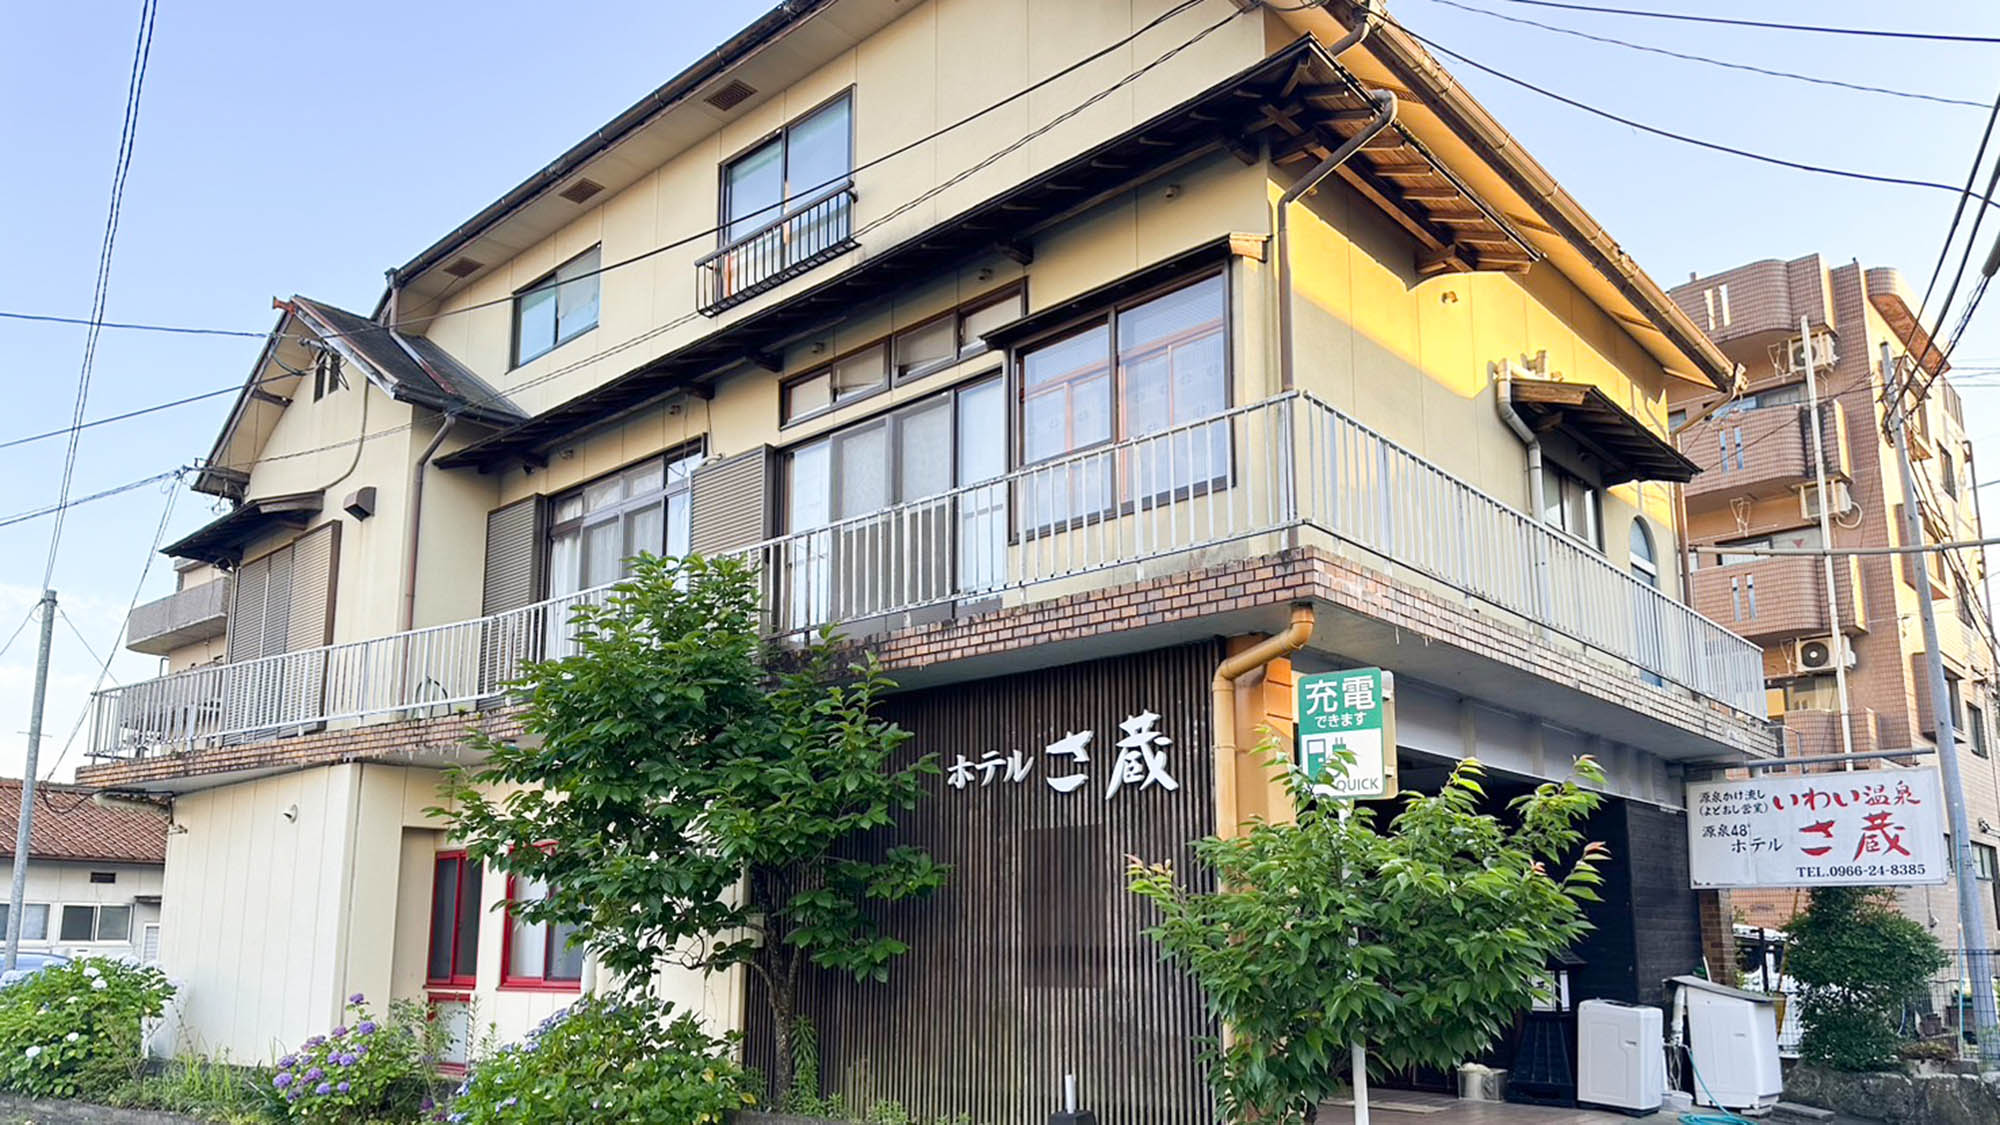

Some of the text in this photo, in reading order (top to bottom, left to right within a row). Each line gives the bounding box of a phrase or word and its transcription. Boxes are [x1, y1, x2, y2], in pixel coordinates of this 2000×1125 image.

[1305, 674, 1376, 715] 充電
[1315, 711, 1367, 728] できます
[947, 709, 1179, 800] ホテル さ蔵
[1336, 777, 1379, 793] QUICK
[1699, 789, 1766, 803] 源泉かけ流し
[1772, 780, 1921, 811] いわい温泉
[1798, 810, 1911, 861] さ蔵
[1731, 837, 1783, 854] ホテル
[1796, 863, 1926, 878] TEL.0966-24-8385
